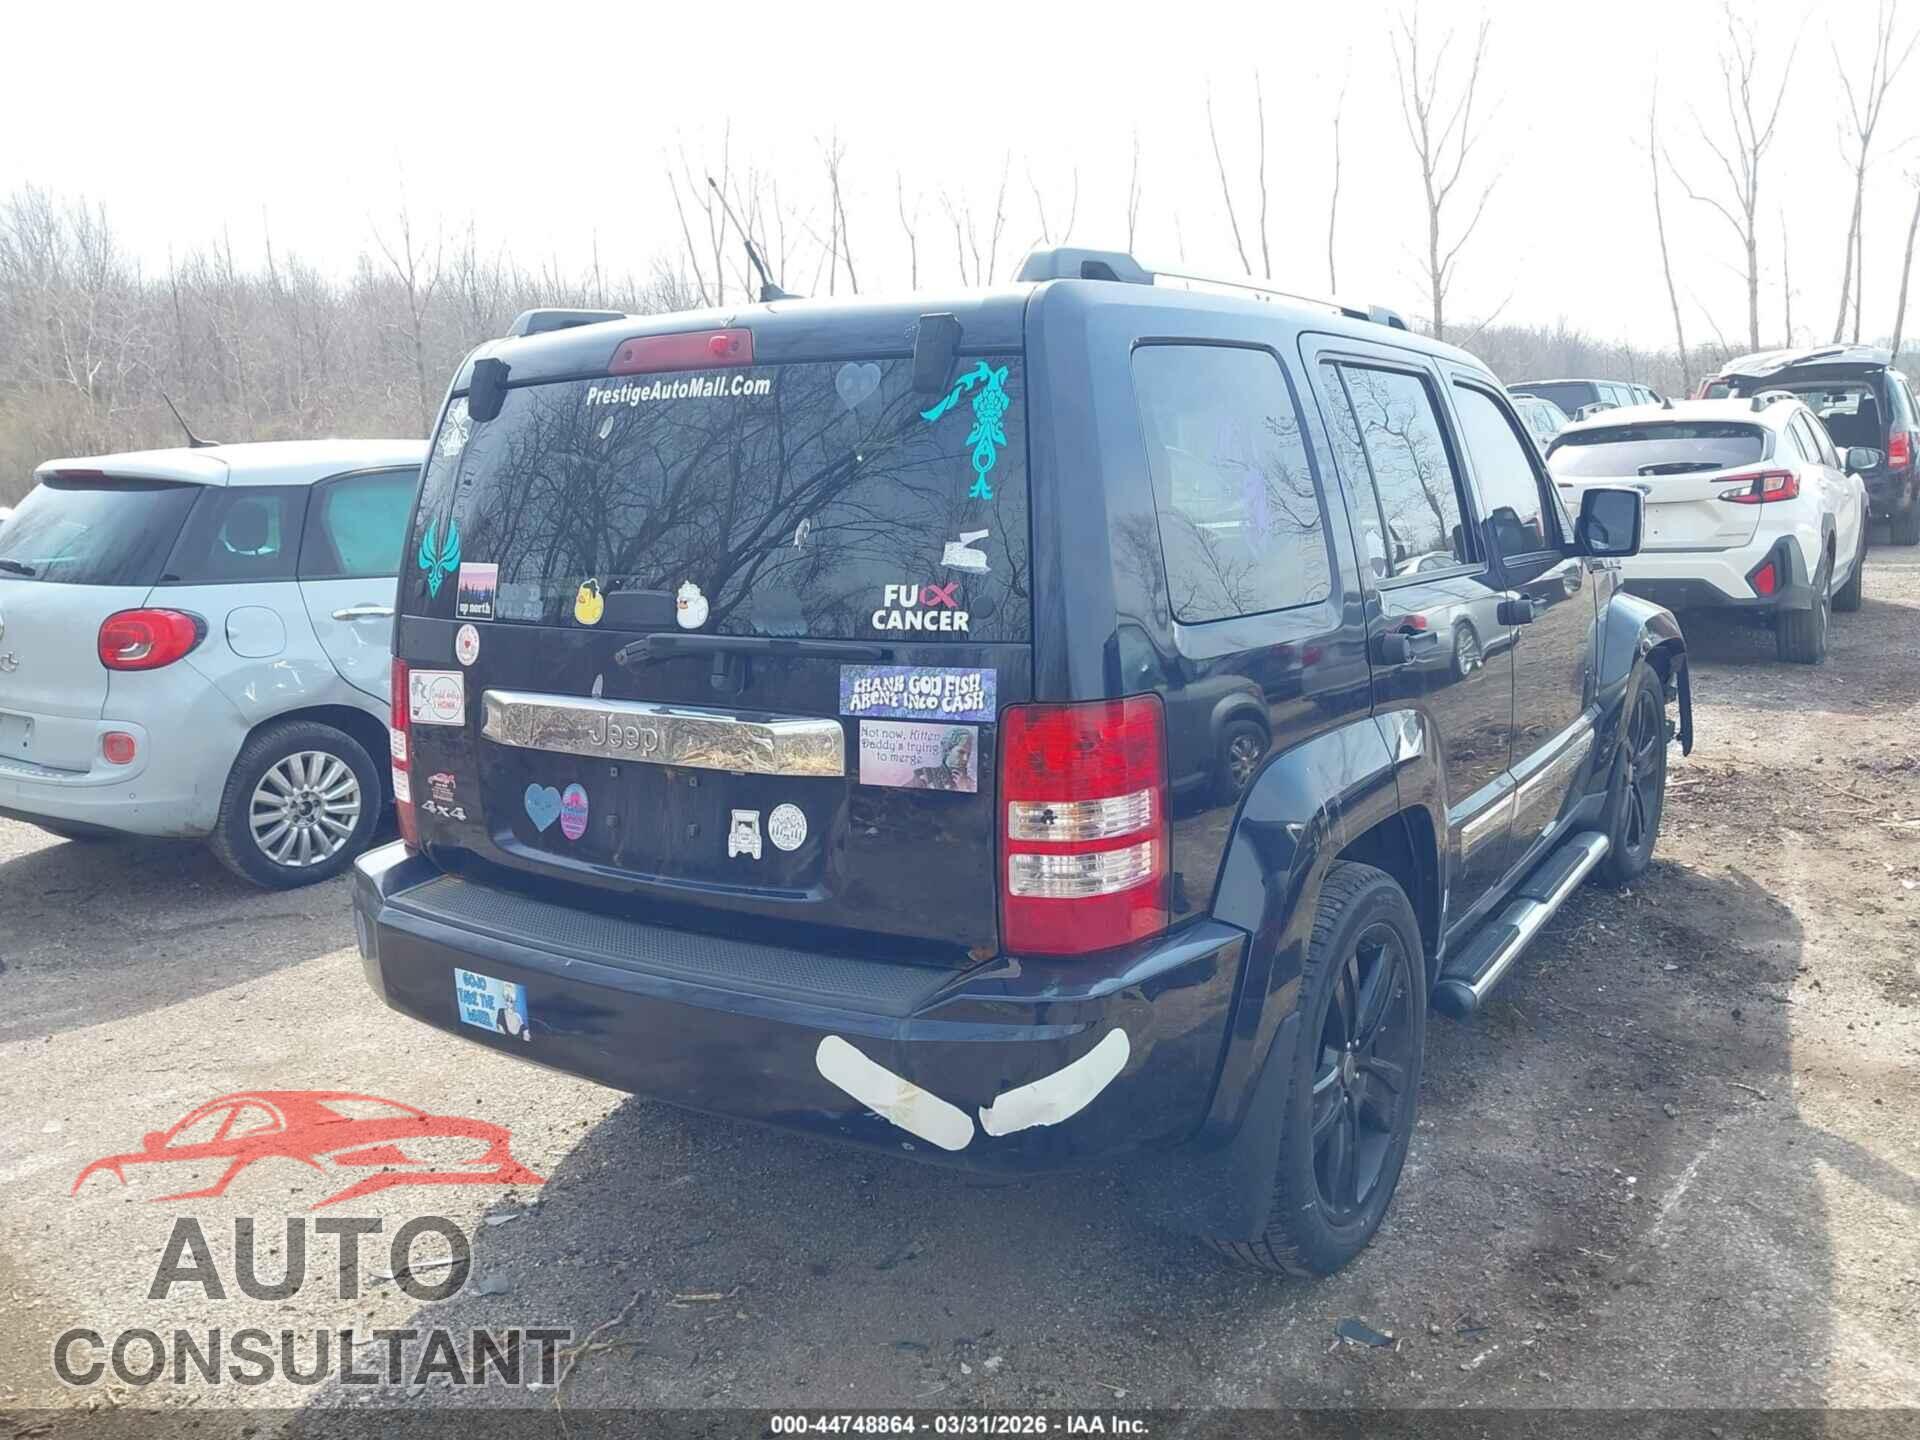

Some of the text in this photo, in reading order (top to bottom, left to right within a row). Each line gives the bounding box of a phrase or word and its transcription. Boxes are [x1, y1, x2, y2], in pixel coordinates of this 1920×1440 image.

[586, 375, 771, 407] PrestigeAutoMall.Com
[469, 602, 491, 614] north
[872, 609, 970, 632] CANCER
[908, 675, 942, 697] GOD
[944, 672, 981, 697] FISH
[941, 691, 985, 713] CASH
[588, 715, 660, 758] Jeep
[860, 727, 881, 738] Not
[421, 799, 467, 821] 4x4
